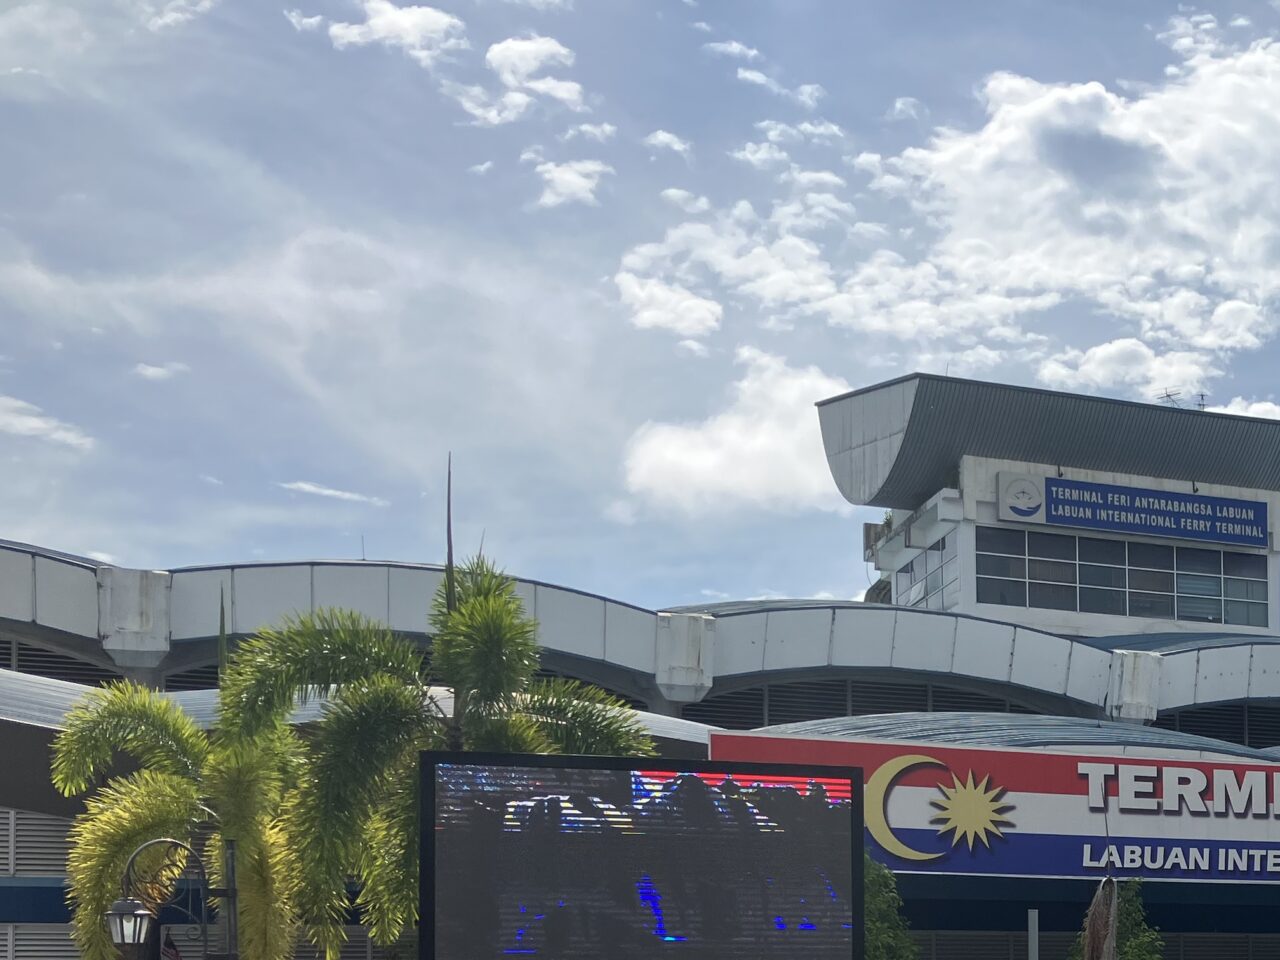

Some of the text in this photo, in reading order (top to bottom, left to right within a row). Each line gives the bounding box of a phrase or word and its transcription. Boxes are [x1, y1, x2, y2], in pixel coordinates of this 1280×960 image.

[1051, 486, 1254, 520] TERMINAL FERI ANTARABANGSA LABUAN
[1051, 503, 1264, 538] LABUAN INTERNATIONAL FERRY TERMINAL
[1082, 844, 1210, 872] LABUAN
